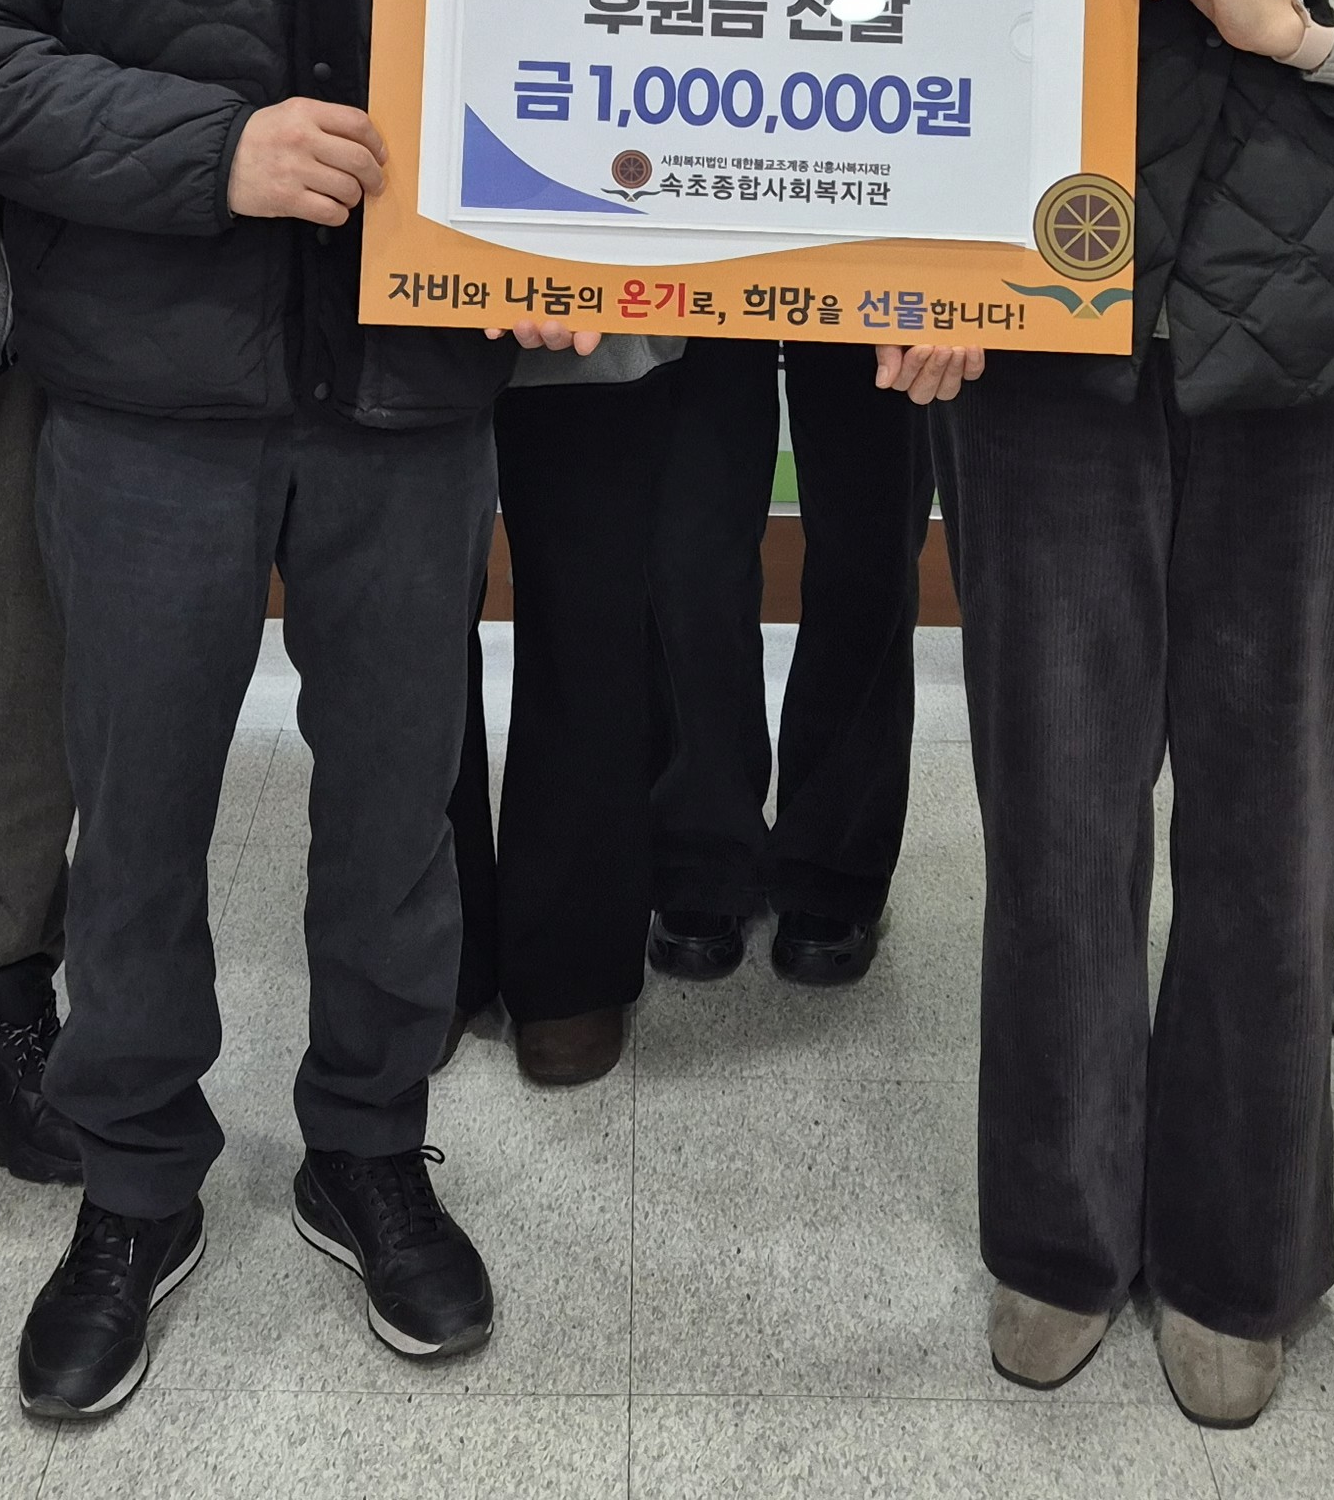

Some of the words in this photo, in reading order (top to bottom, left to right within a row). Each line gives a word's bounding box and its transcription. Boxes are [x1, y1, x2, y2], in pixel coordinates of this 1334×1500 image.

[660, 154, 728, 170] 사회복지법인
[731, 156, 808, 173] 대한불교조계종
[812, 159, 891, 177] 신흥사복지재단
[659, 172, 891, 206] 속초종합사회복지관
[388, 272, 490, 309] 자비와
[505, 277, 603, 316] 나눔의
[617, 279, 727, 325] 온기로,
[742, 284, 843, 326] 희망을
[857, 289, 1026, 331] 선물합니다!
